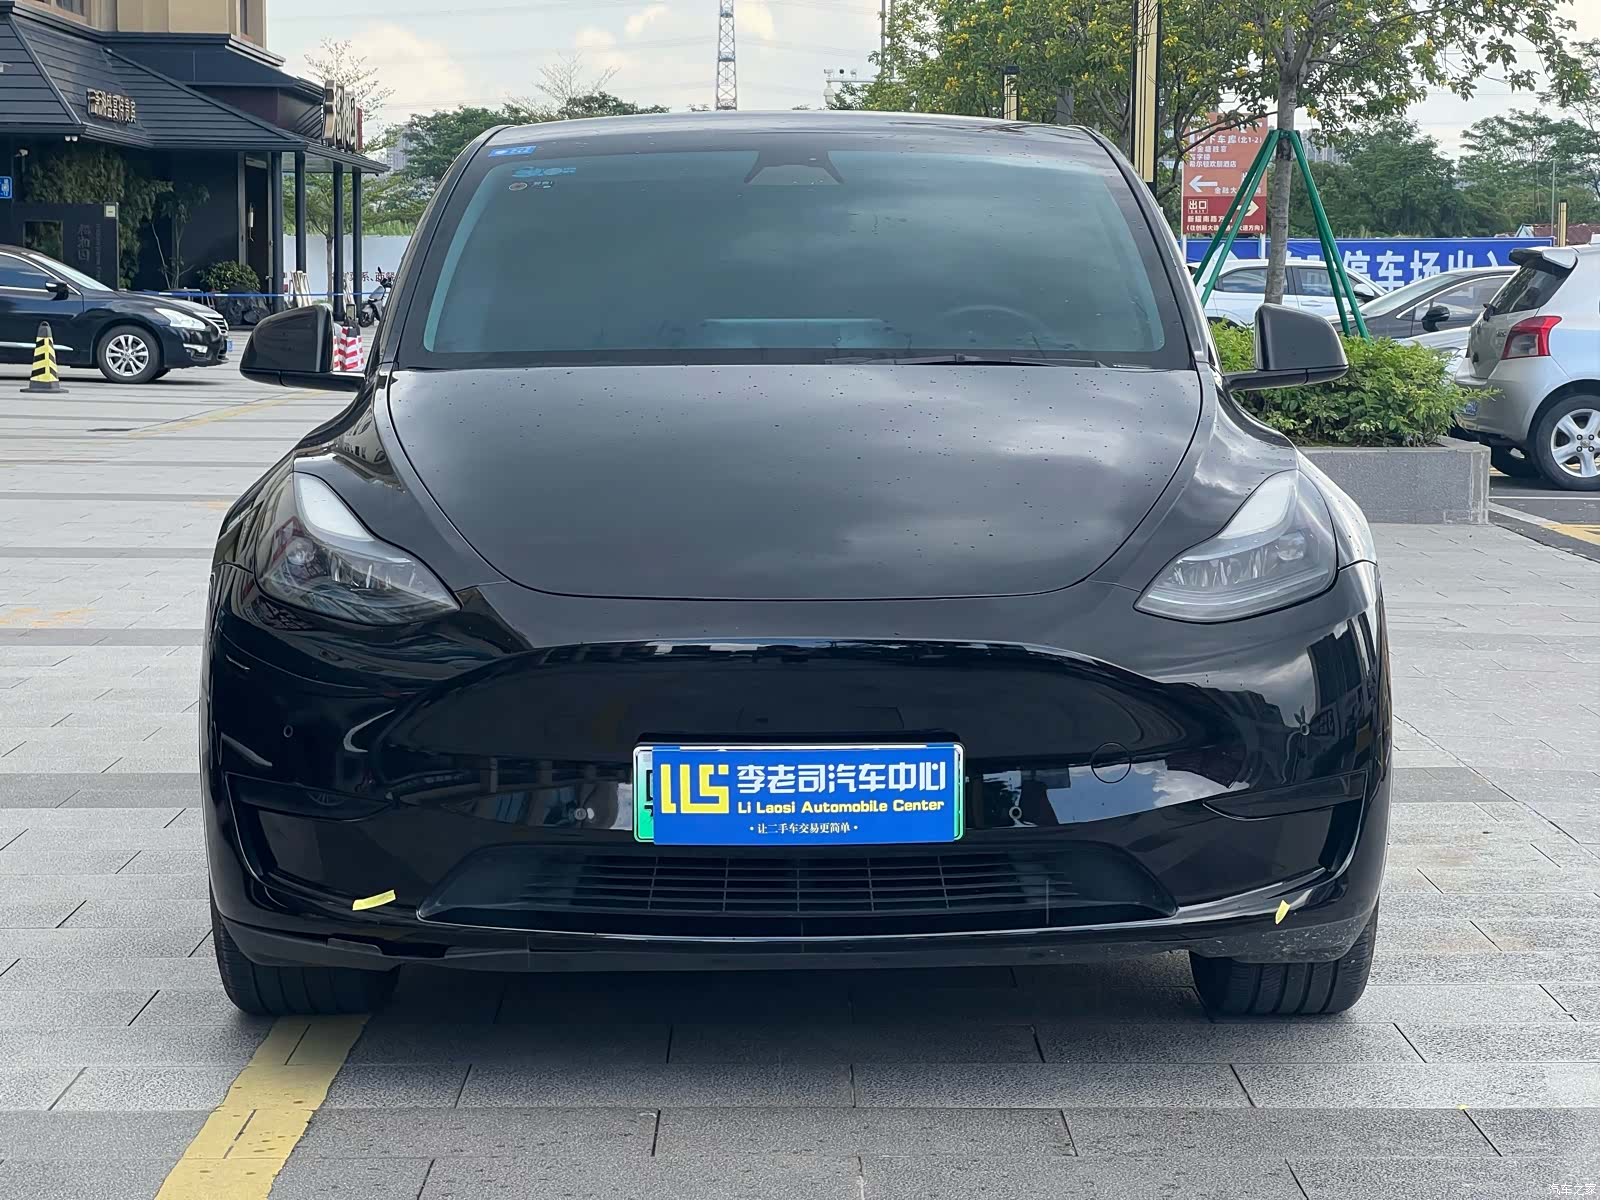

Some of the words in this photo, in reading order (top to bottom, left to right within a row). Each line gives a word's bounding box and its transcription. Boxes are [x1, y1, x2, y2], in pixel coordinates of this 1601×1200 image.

[1189, 200, 1207, 210] 出口
[736, 761, 947, 794] 李老司汽车中心
[737, 801, 752, 815] Li
[756, 800, 796, 815] Laosi
[892, 798, 945, 813] Center
[756, 821, 852, 835] 让二手车交易更简单
